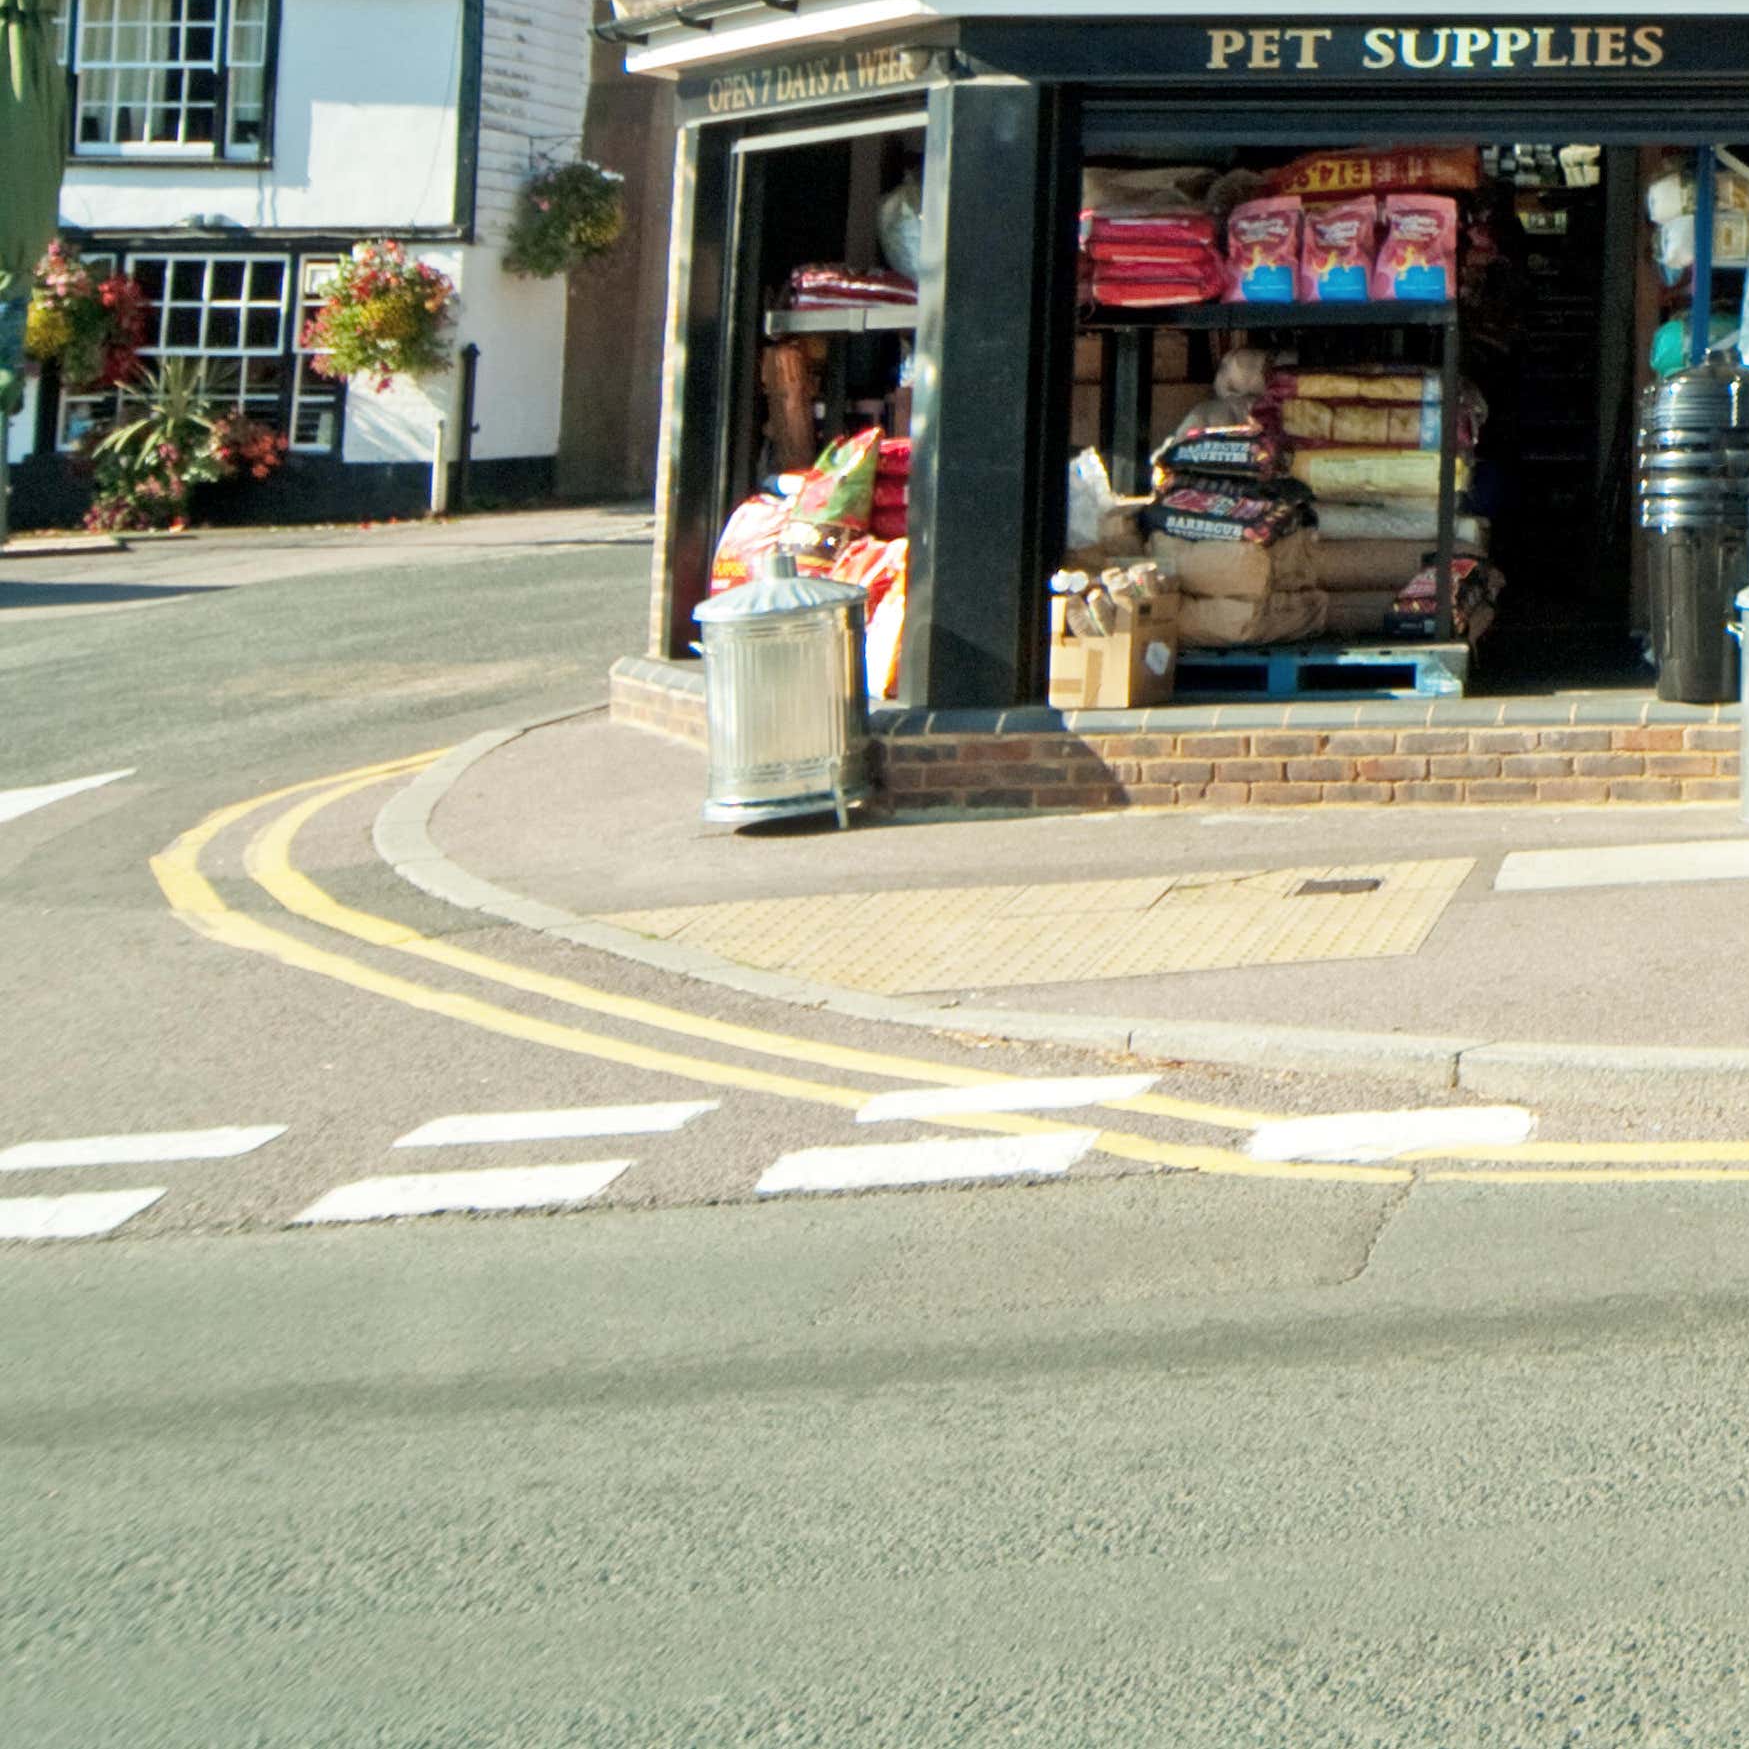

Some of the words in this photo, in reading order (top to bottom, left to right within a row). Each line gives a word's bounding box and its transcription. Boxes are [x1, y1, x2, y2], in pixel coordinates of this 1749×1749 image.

[1206, 28, 1332, 69] PET
[1362, 26, 1664, 69] SUPPLIES
[708, 71, 756, 112] OPEN
[760, 69, 772, 103] 7
[776, 57, 829, 101] DAYS
[832, 54, 849, 93] A
